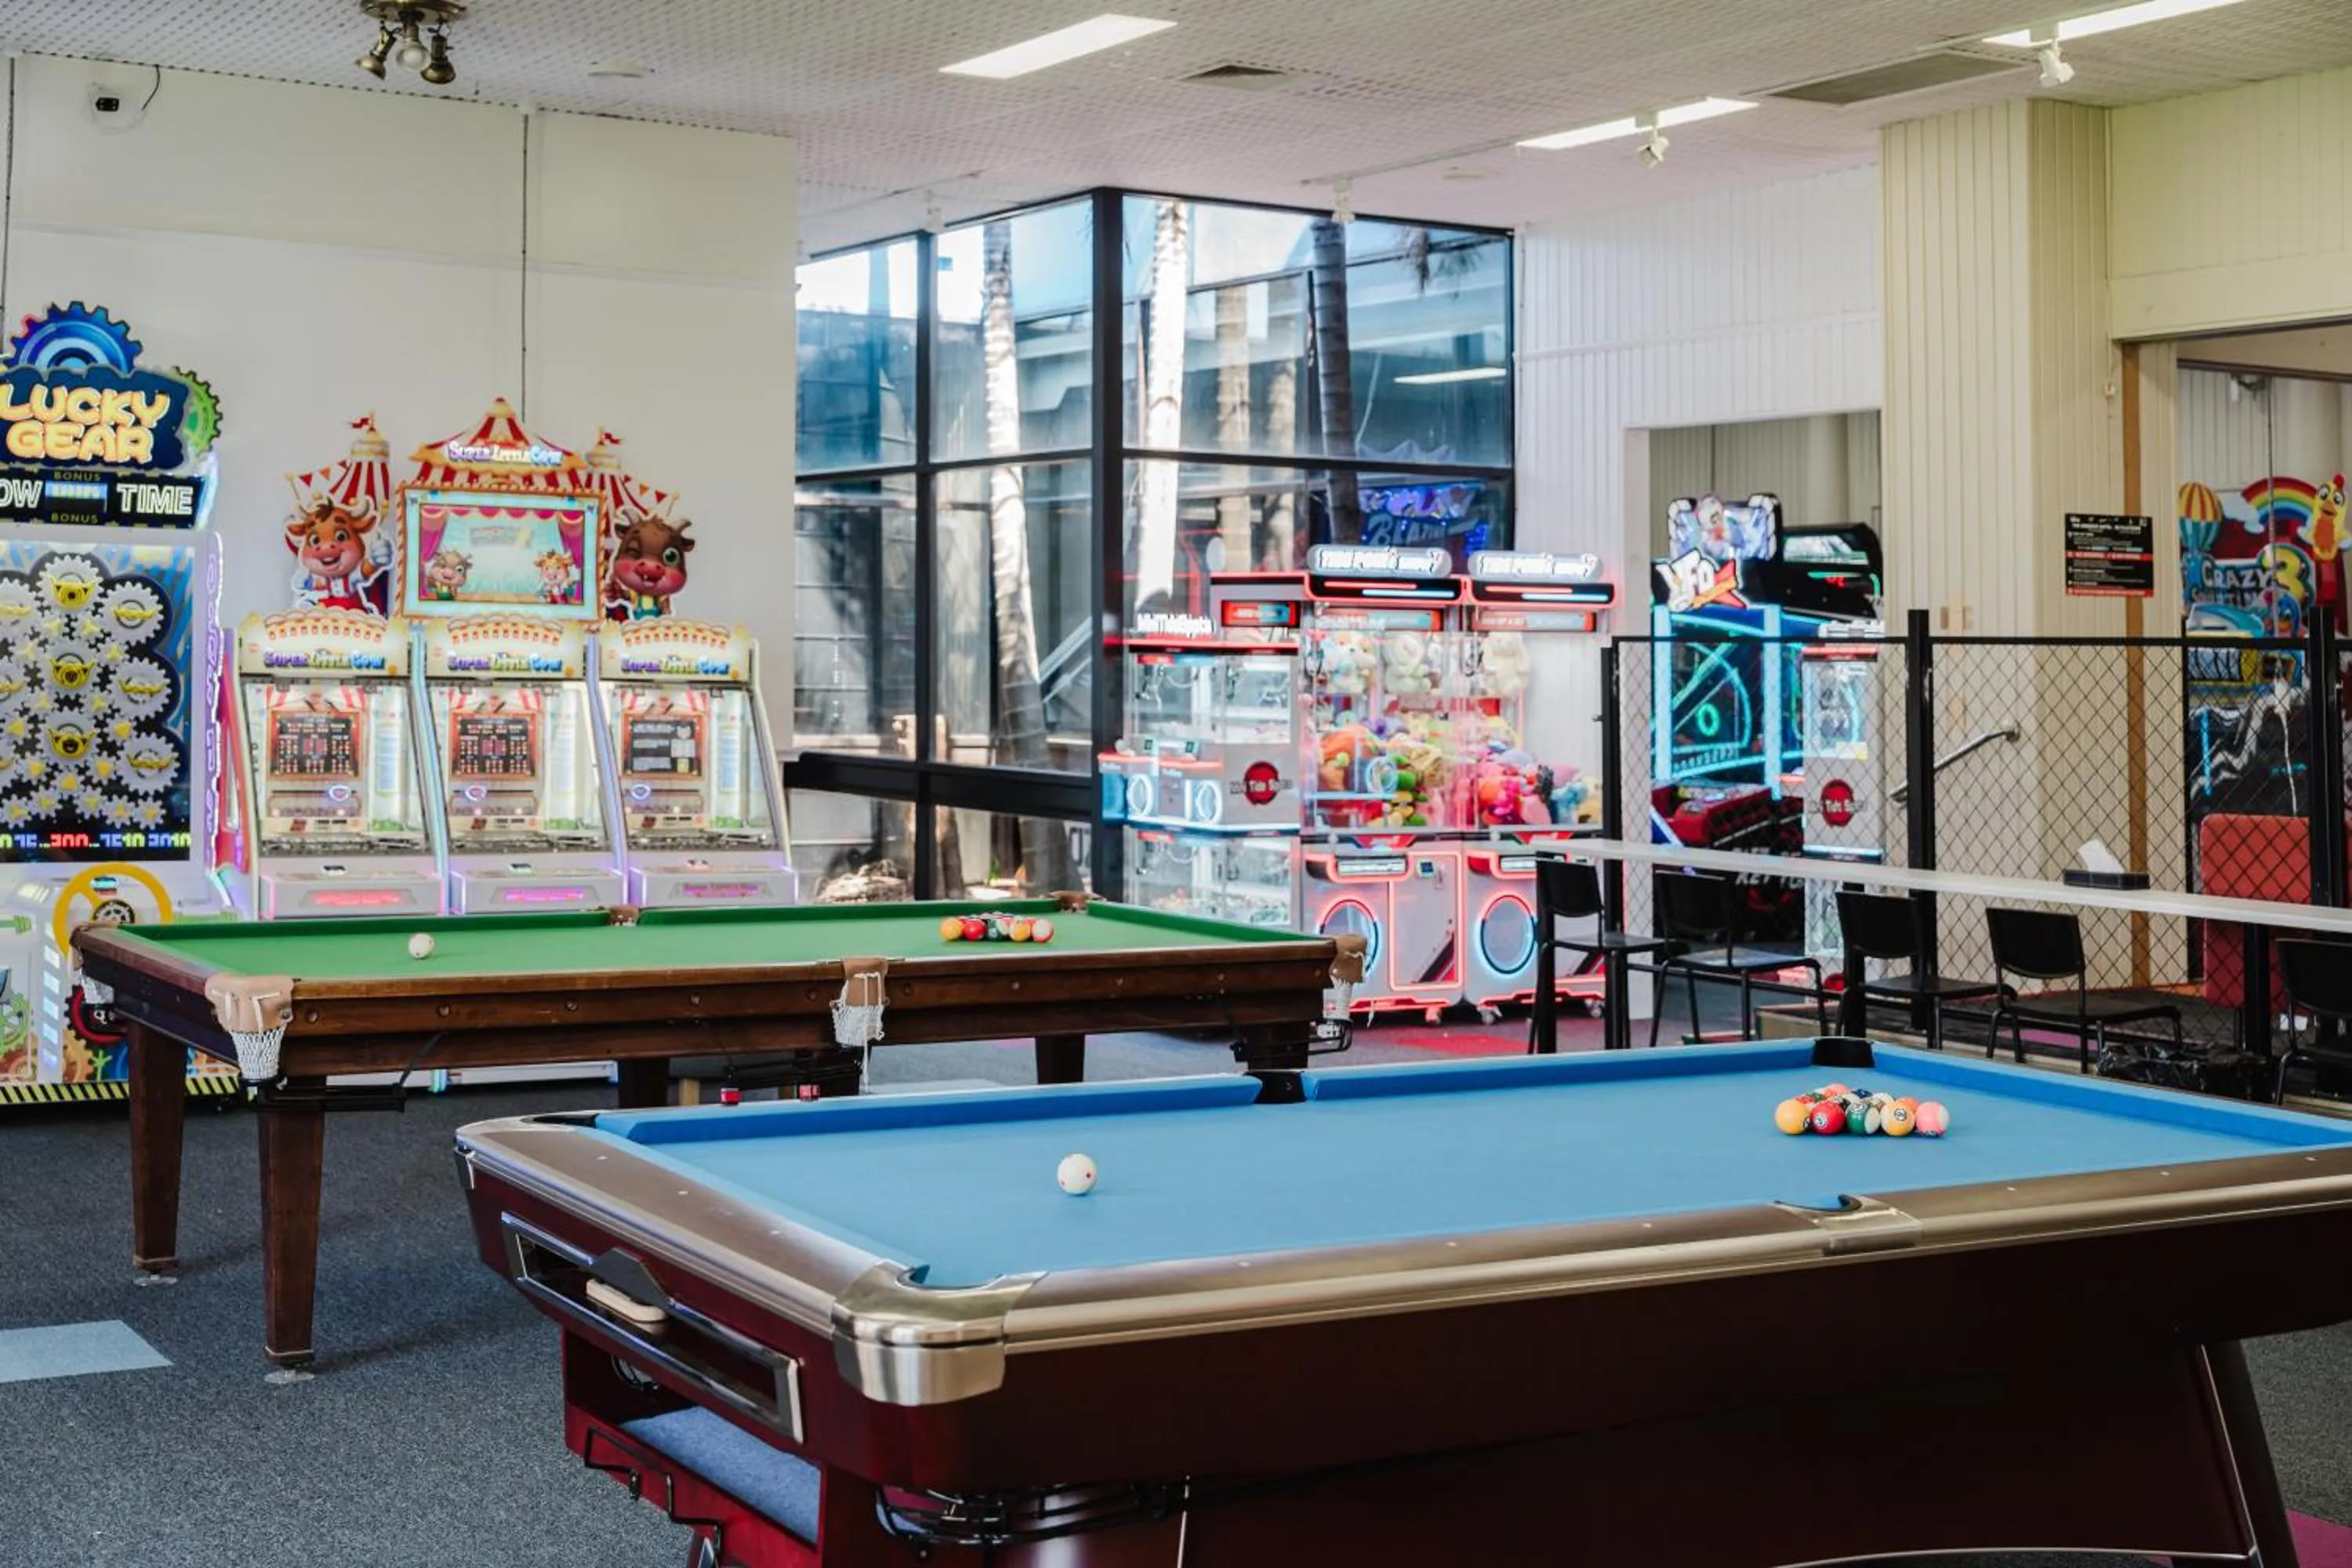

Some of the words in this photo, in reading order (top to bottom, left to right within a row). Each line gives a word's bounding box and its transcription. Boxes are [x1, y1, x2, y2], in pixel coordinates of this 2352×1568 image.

[0, 383, 170, 428] LUCKY
[6, 420, 154, 464] GEAR
[54, 471, 101, 481] BONUS
[117, 484, 194, 514] TIME
[51, 513, 99, 524] BONUS
[2202, 560, 2271, 587] CRAZY
